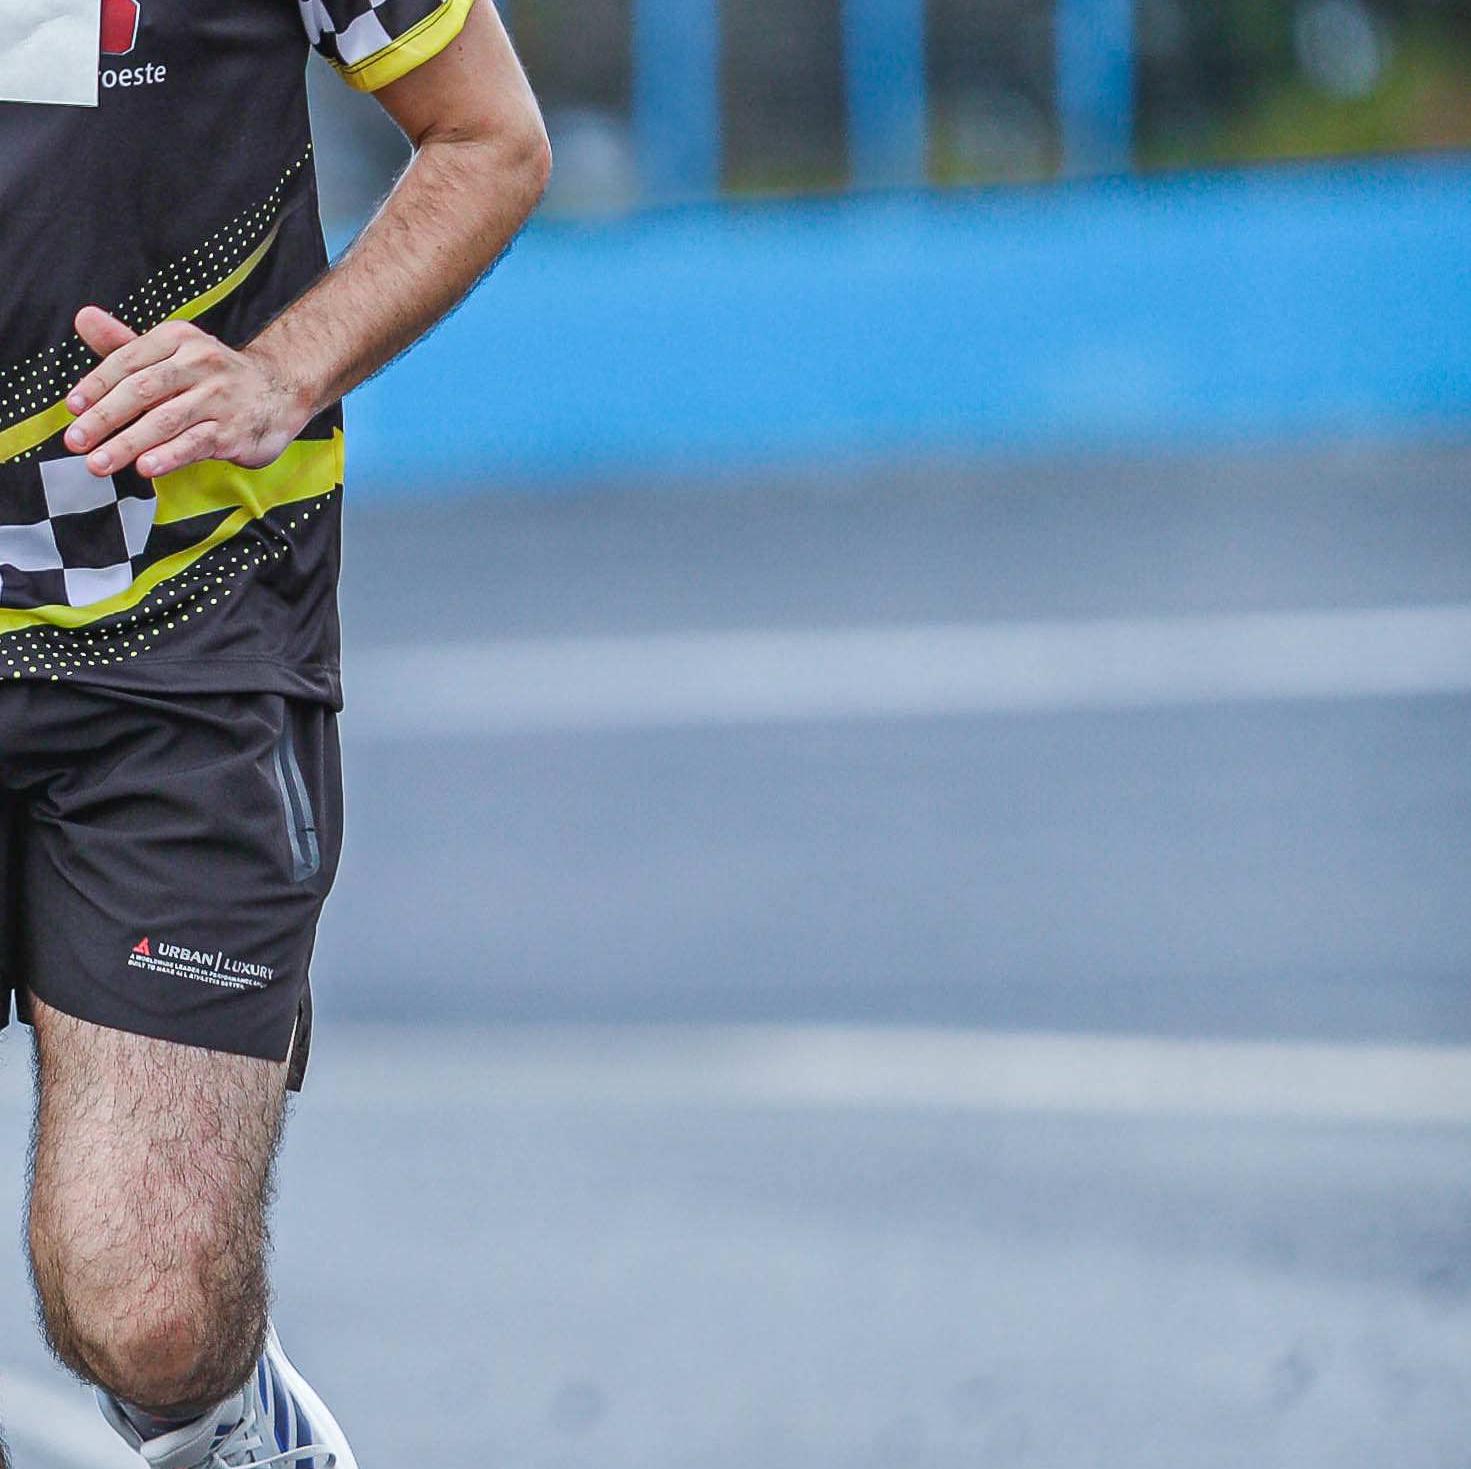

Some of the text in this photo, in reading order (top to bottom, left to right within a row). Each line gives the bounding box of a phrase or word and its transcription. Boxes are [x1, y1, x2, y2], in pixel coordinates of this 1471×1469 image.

[98, 62, 167, 89] oeste
[158, 942, 274, 980] URBAN LUXURY
